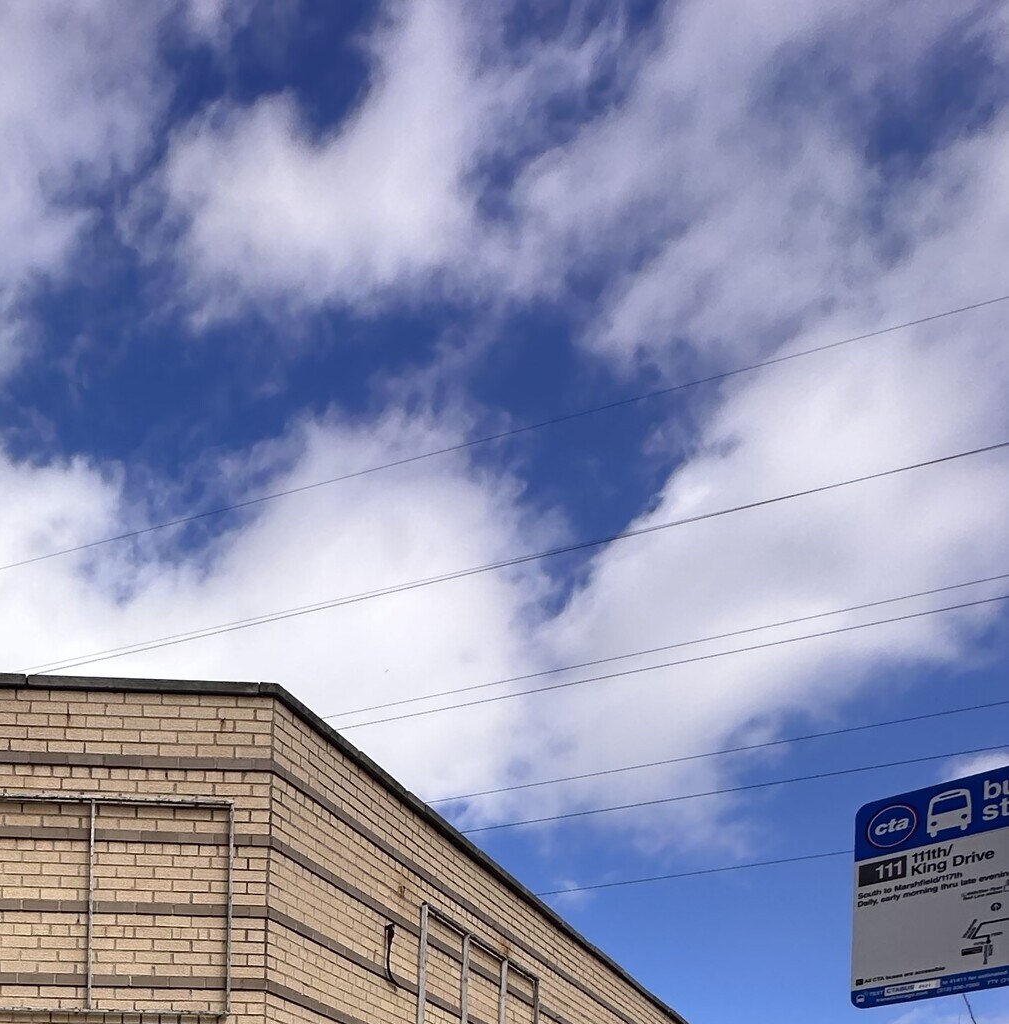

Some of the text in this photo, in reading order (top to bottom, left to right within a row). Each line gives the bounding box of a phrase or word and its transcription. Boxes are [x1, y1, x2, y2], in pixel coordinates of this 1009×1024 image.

[874, 818, 910, 835] cta
[911, 850, 995, 876] King Drive
[912, 844, 953, 864] 111th/
[875, 860, 902, 879] 111
[857, 872, 963, 900] South to Marshfield/117th
[880, 893, 901, 902] early
[902, 885, 939, 898] morning
[941, 881, 959, 891] thru
[960, 878, 977, 887] late
